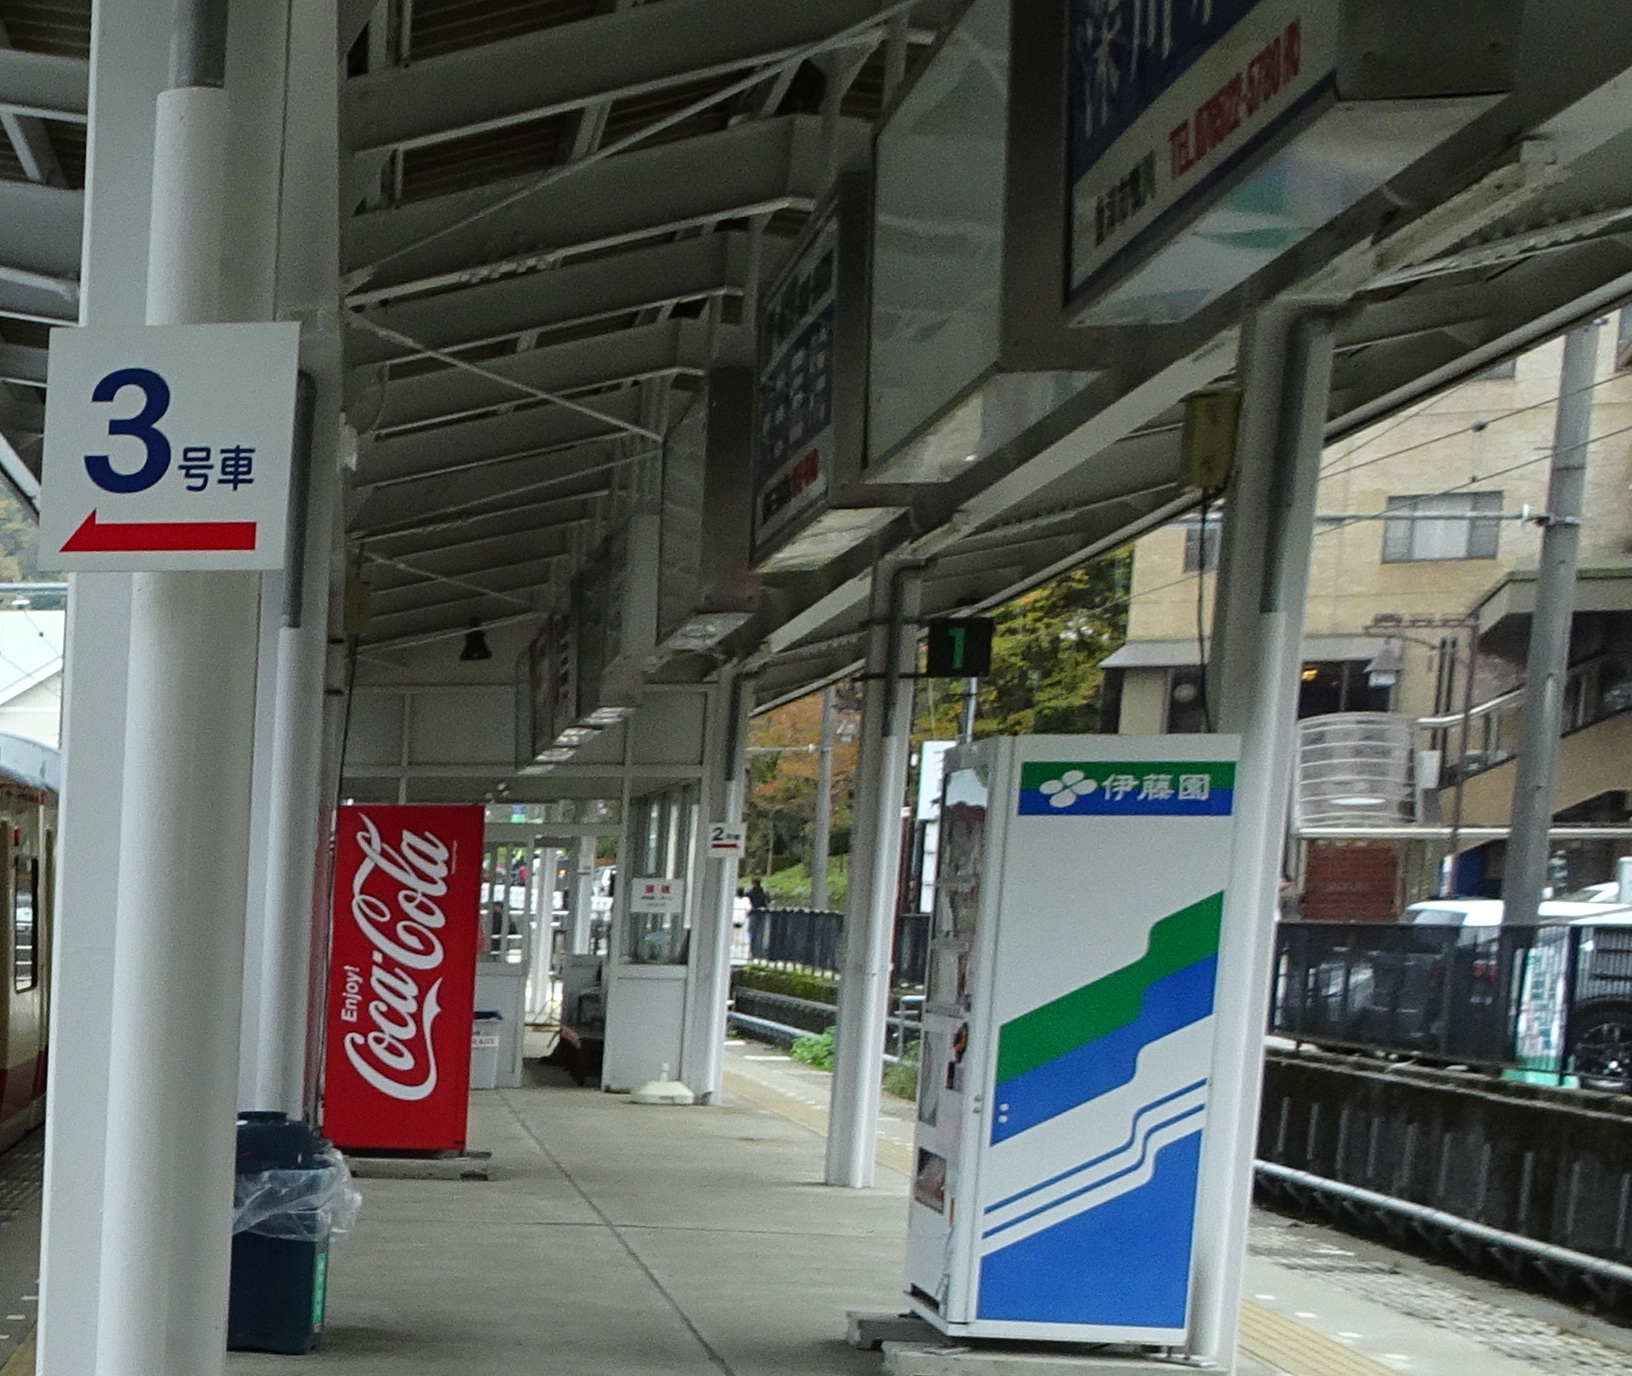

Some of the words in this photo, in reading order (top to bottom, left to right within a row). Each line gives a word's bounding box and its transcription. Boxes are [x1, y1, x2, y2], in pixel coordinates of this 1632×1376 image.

[84, 367, 255, 494] 3号車
[1101, 772, 1213, 802] 伊藤園
[341, 965, 363, 1022] Enjoy!
[344, 812, 449, 1100] Coca-Cola
